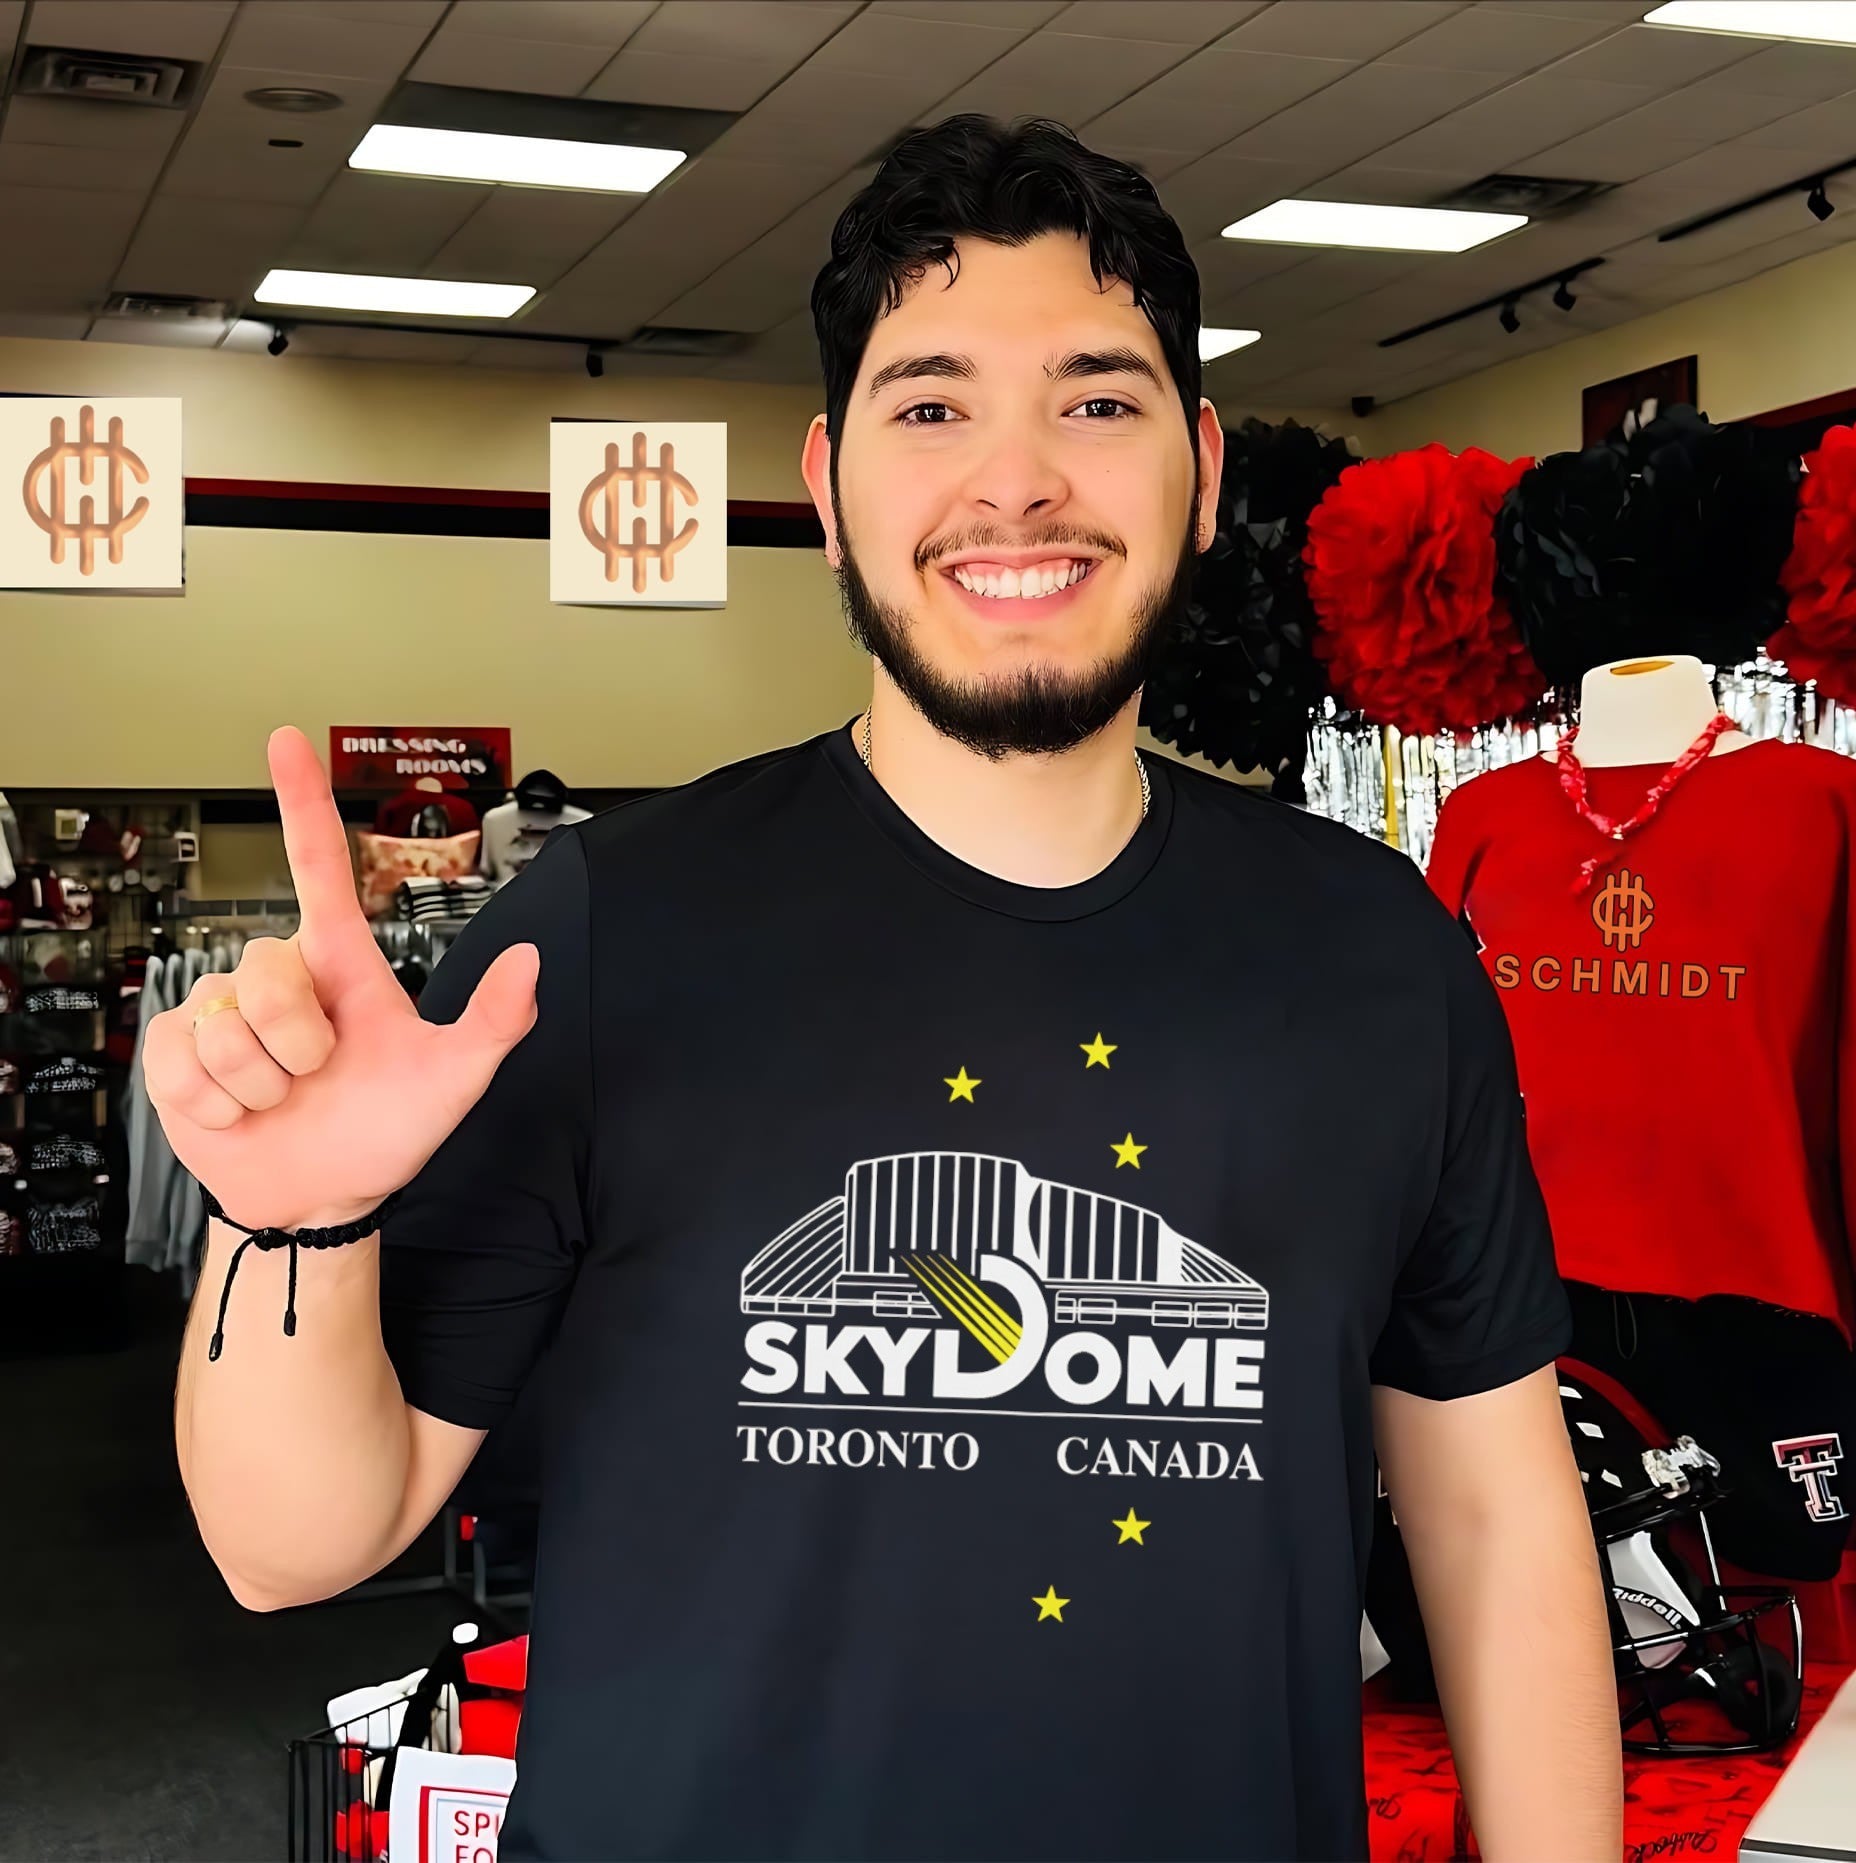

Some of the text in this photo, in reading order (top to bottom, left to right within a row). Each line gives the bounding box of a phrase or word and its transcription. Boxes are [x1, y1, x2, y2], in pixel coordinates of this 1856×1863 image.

[342, 737, 466, 753] DRESSING
[395, 758, 487, 775] ROOMS
[1494, 954, 1747, 1000] SCHMIDT
[740, 1254, 1266, 1409] SKYDOME
[737, 1426, 1264, 1481] TORONTO CANADA
